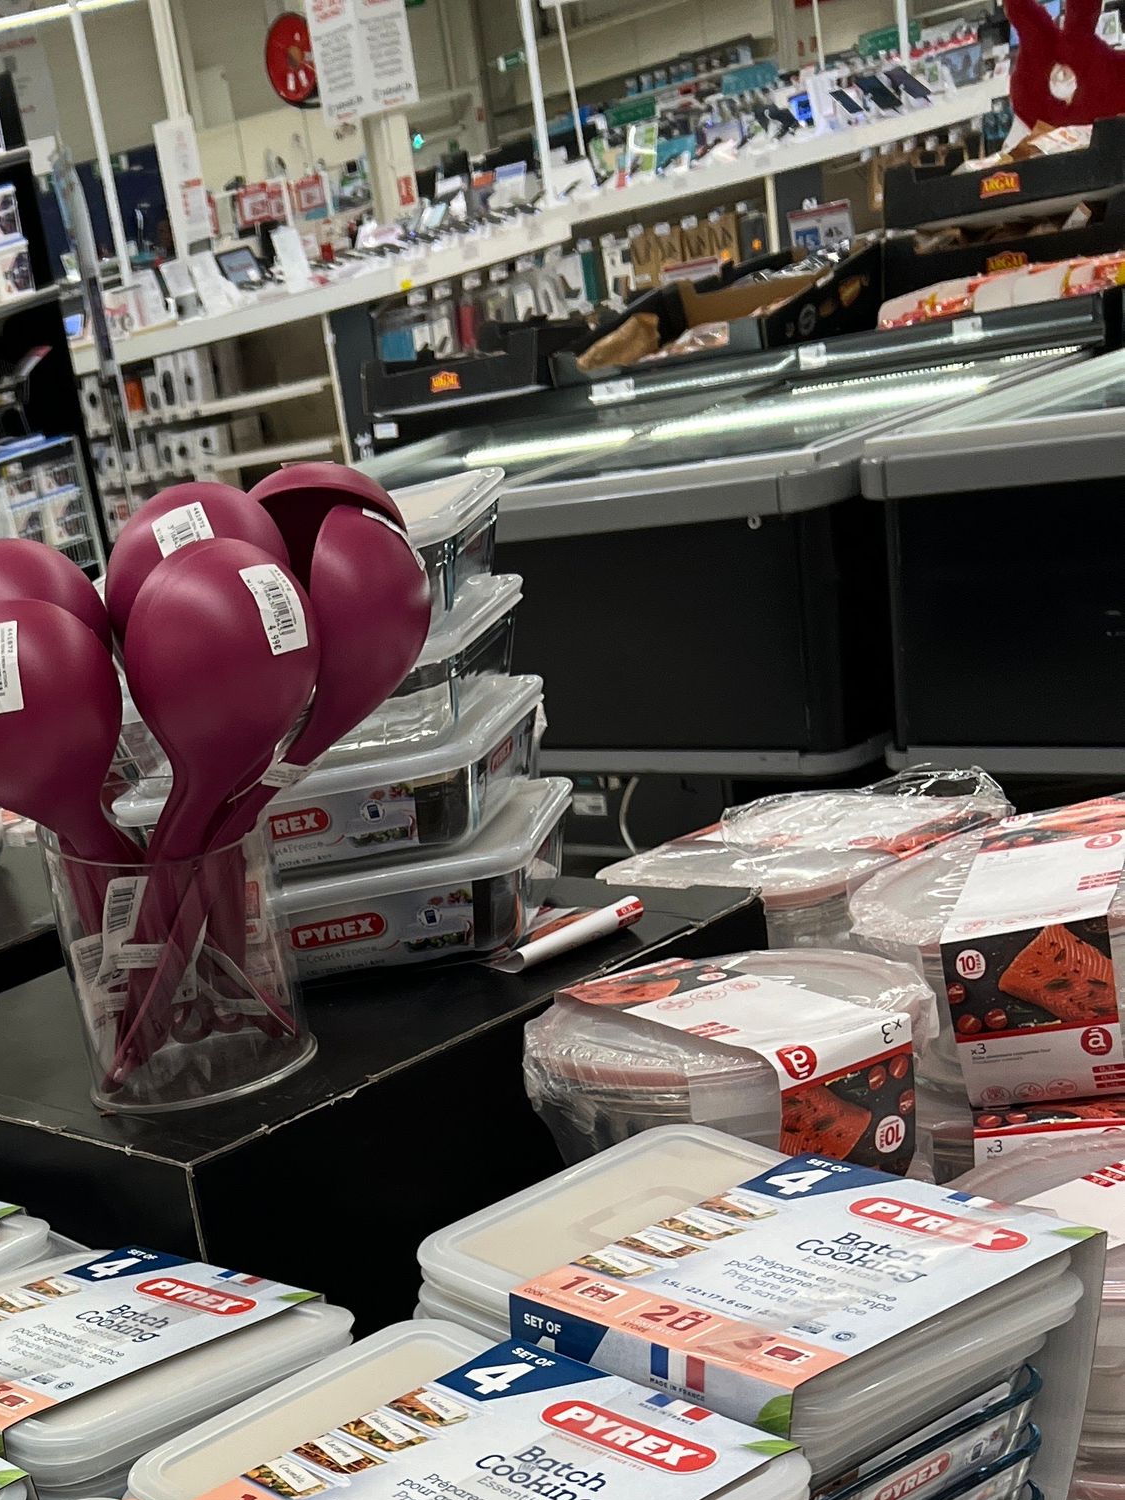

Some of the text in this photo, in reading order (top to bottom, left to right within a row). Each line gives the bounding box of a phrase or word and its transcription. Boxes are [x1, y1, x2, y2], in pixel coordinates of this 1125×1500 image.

[270, 813, 320, 835] REX
[297, 918, 375, 946] PYREX
[959, 956, 975, 972] 10
[881, 1018, 903, 1045] x3
[970, 1043, 987, 1056] x3
[764, 1168, 831, 1196] 4
[86, 1257, 142, 1278] 4
[145, 1281, 249, 1312] PYREX
[75, 1310, 161, 1343] Cooking
[107, 1304, 169, 1329] Batch
[524, 1313, 561, 1335] SET OF
[512, 1347, 556, 1369] SET OF
[464, 1362, 536, 1395] 4
[553, 1406, 699, 1469] PYREX
[514, 1445, 606, 1493] Batch
